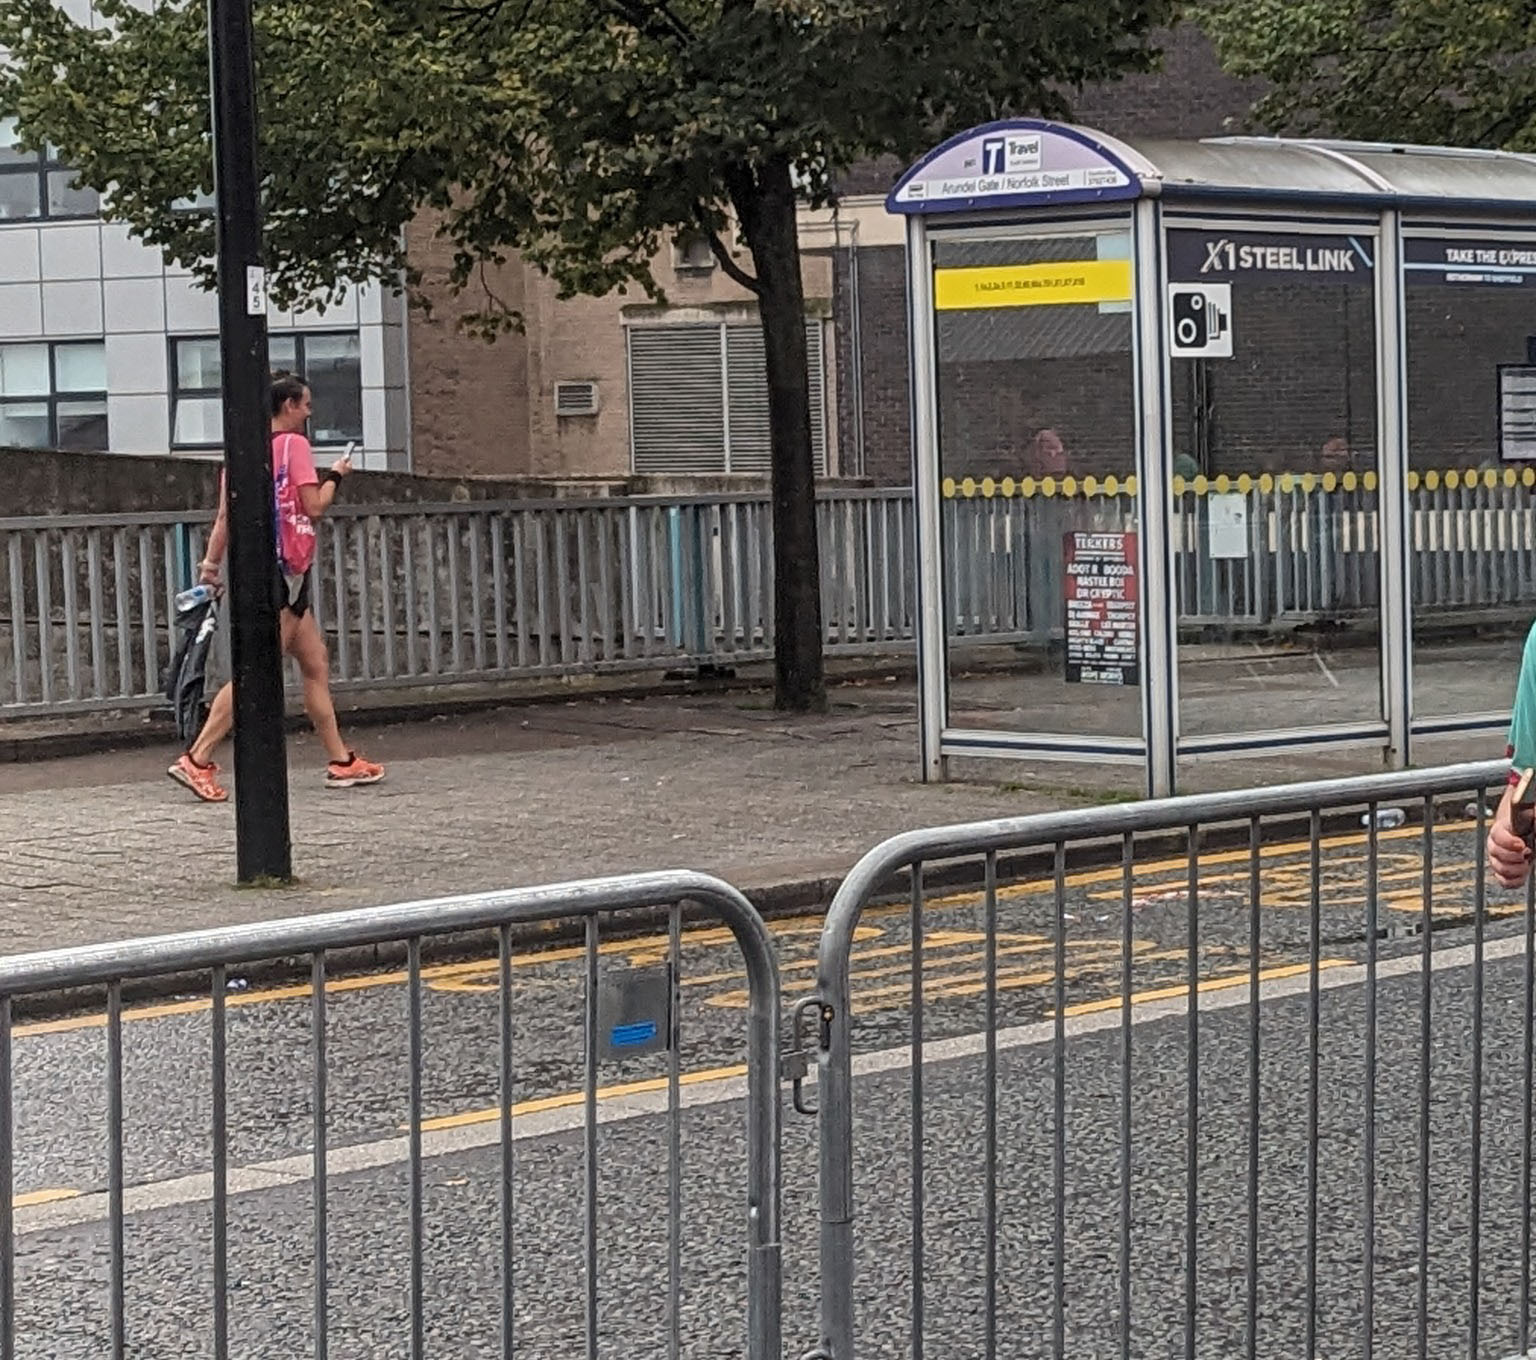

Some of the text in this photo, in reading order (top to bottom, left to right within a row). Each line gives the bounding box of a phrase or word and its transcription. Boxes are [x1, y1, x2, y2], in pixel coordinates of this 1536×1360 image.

[942, 180, 977, 195] Arundel
[978, 178, 1000, 191] Gate
[1008, 175, 1040, 188] Norfolk
[1042, 173, 1070, 186] Street
[1200, 239, 1237, 273] X1
[1306, 248, 1355, 272] LINK
[1446, 248, 1474, 263] TAKE
[1475, 249, 1497, 264] THE
